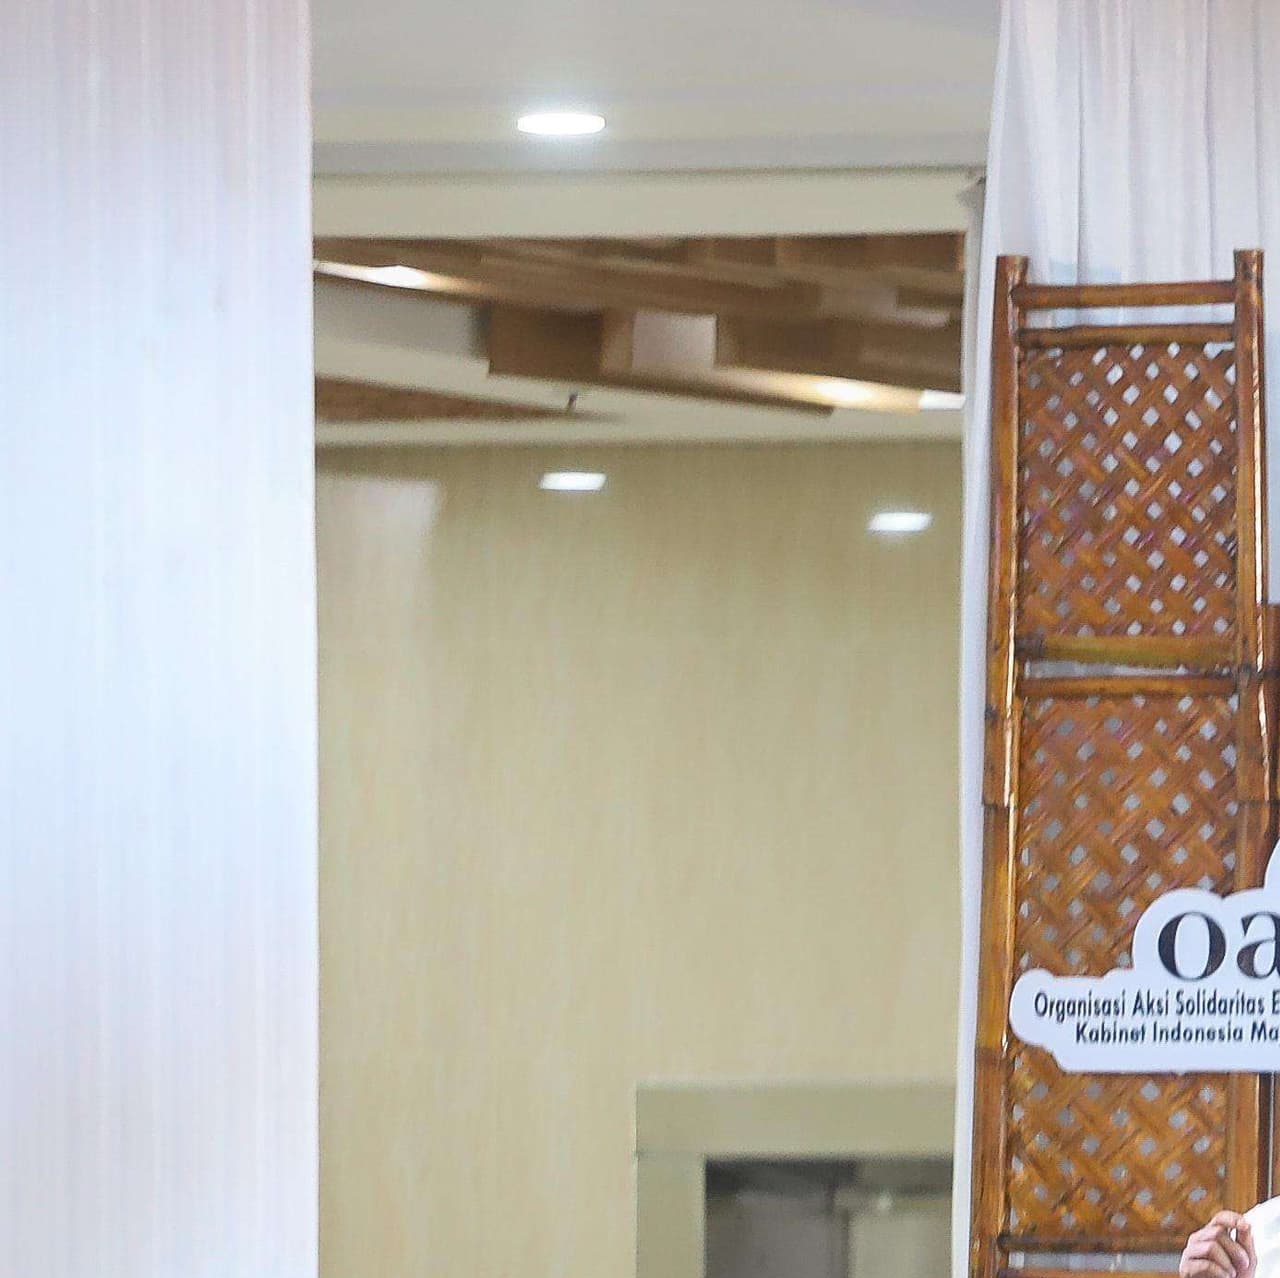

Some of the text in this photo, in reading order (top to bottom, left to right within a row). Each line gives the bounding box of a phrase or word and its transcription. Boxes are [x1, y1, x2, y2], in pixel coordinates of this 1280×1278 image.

[1033, 989, 1126, 1024] Organisasi
[1132, 988, 1170, 1017] Aksi
[1175, 988, 1265, 1017] Solidaritas
[1075, 1020, 1147, 1044] Kabinet
[1152, 1019, 1244, 1044] Indonesia
